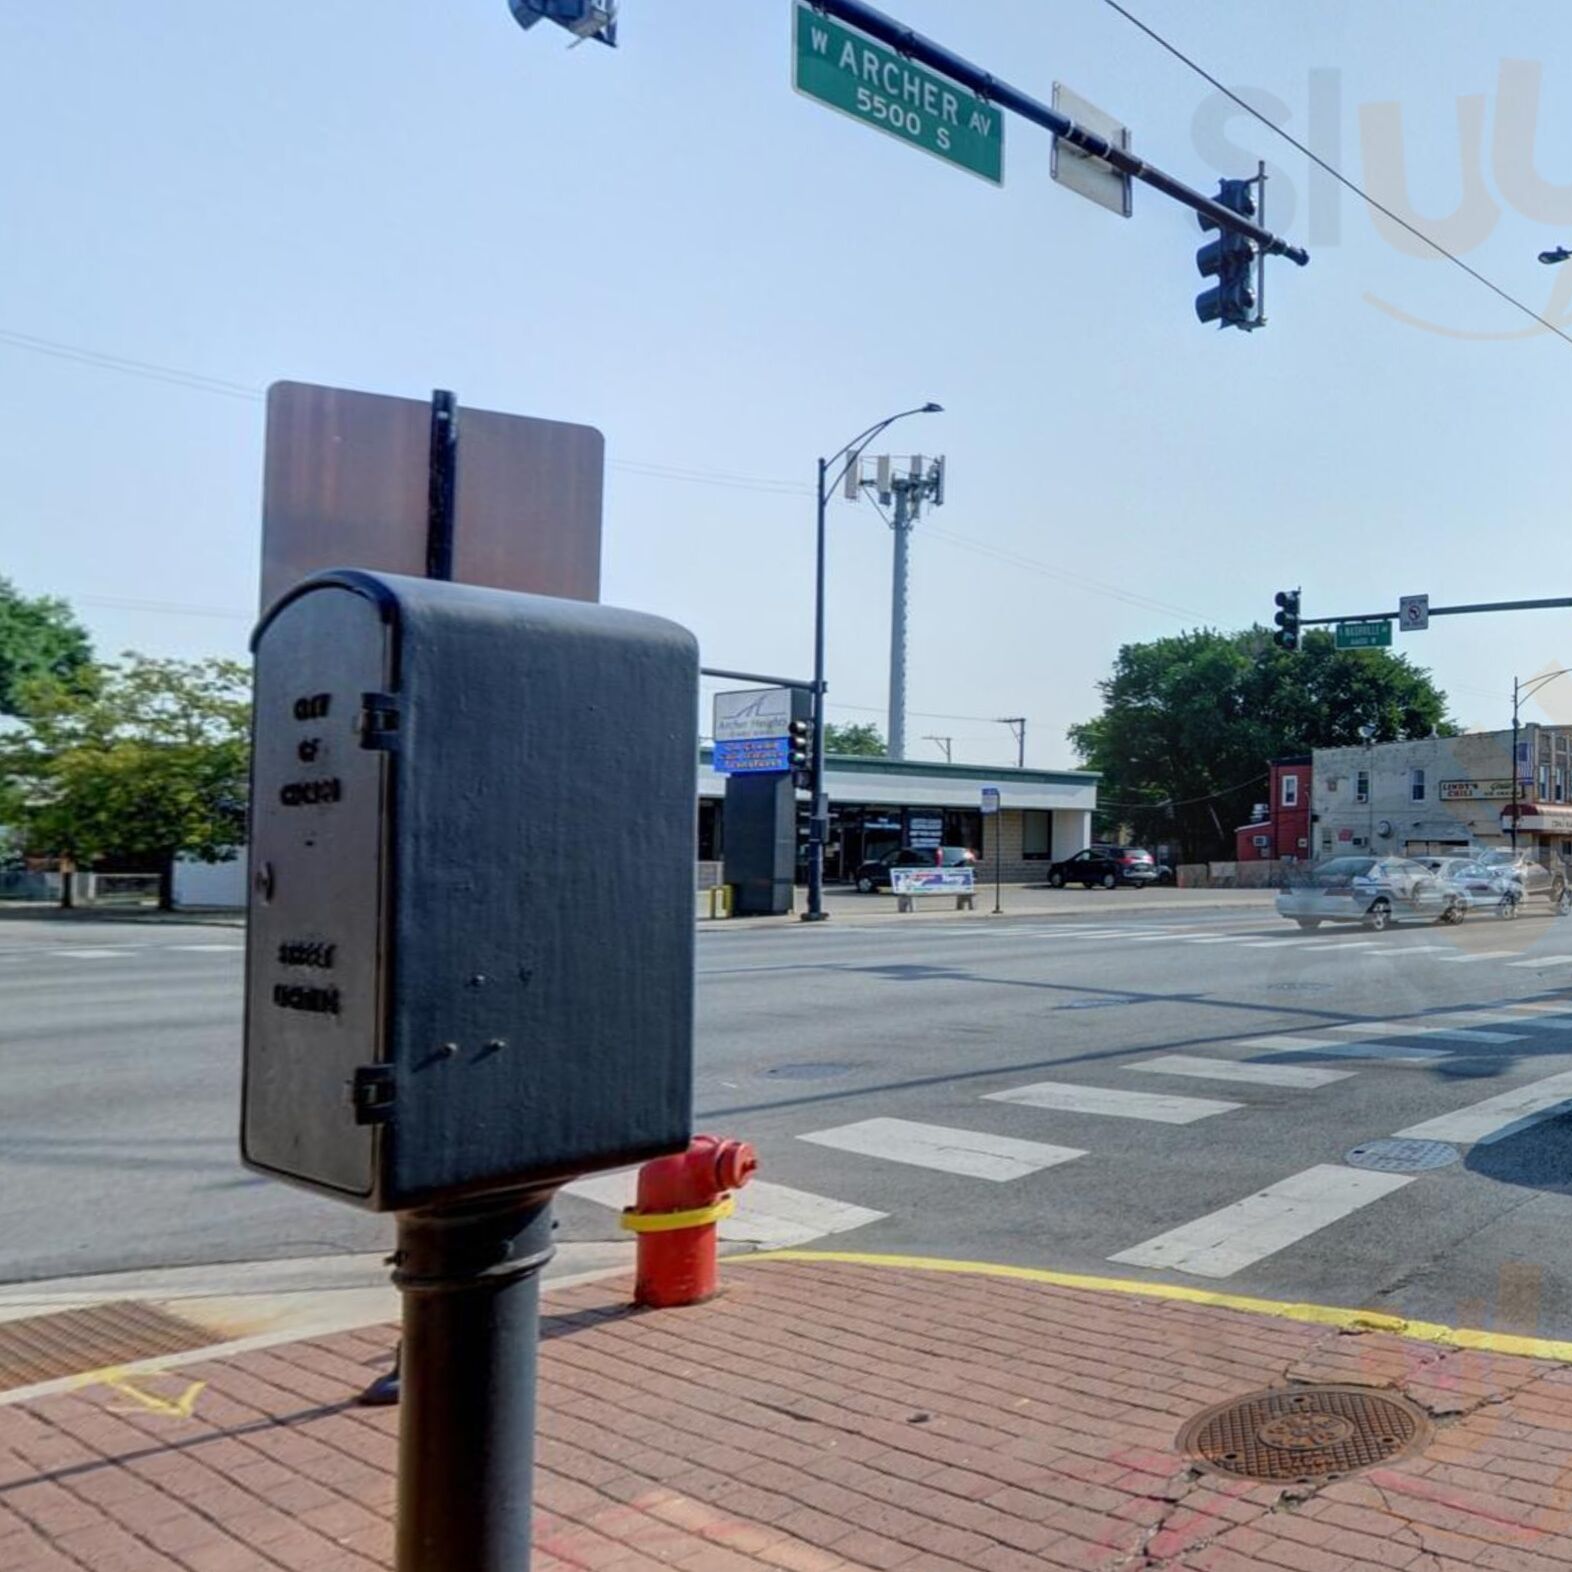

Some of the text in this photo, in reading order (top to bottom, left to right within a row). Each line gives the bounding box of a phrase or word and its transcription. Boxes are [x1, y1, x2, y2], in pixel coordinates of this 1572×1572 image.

[811, 26, 991, 137] W ARCHER AV
[856, 86, 950, 150] 5500 S
[1442, 783, 1478, 791] LINDY'S
